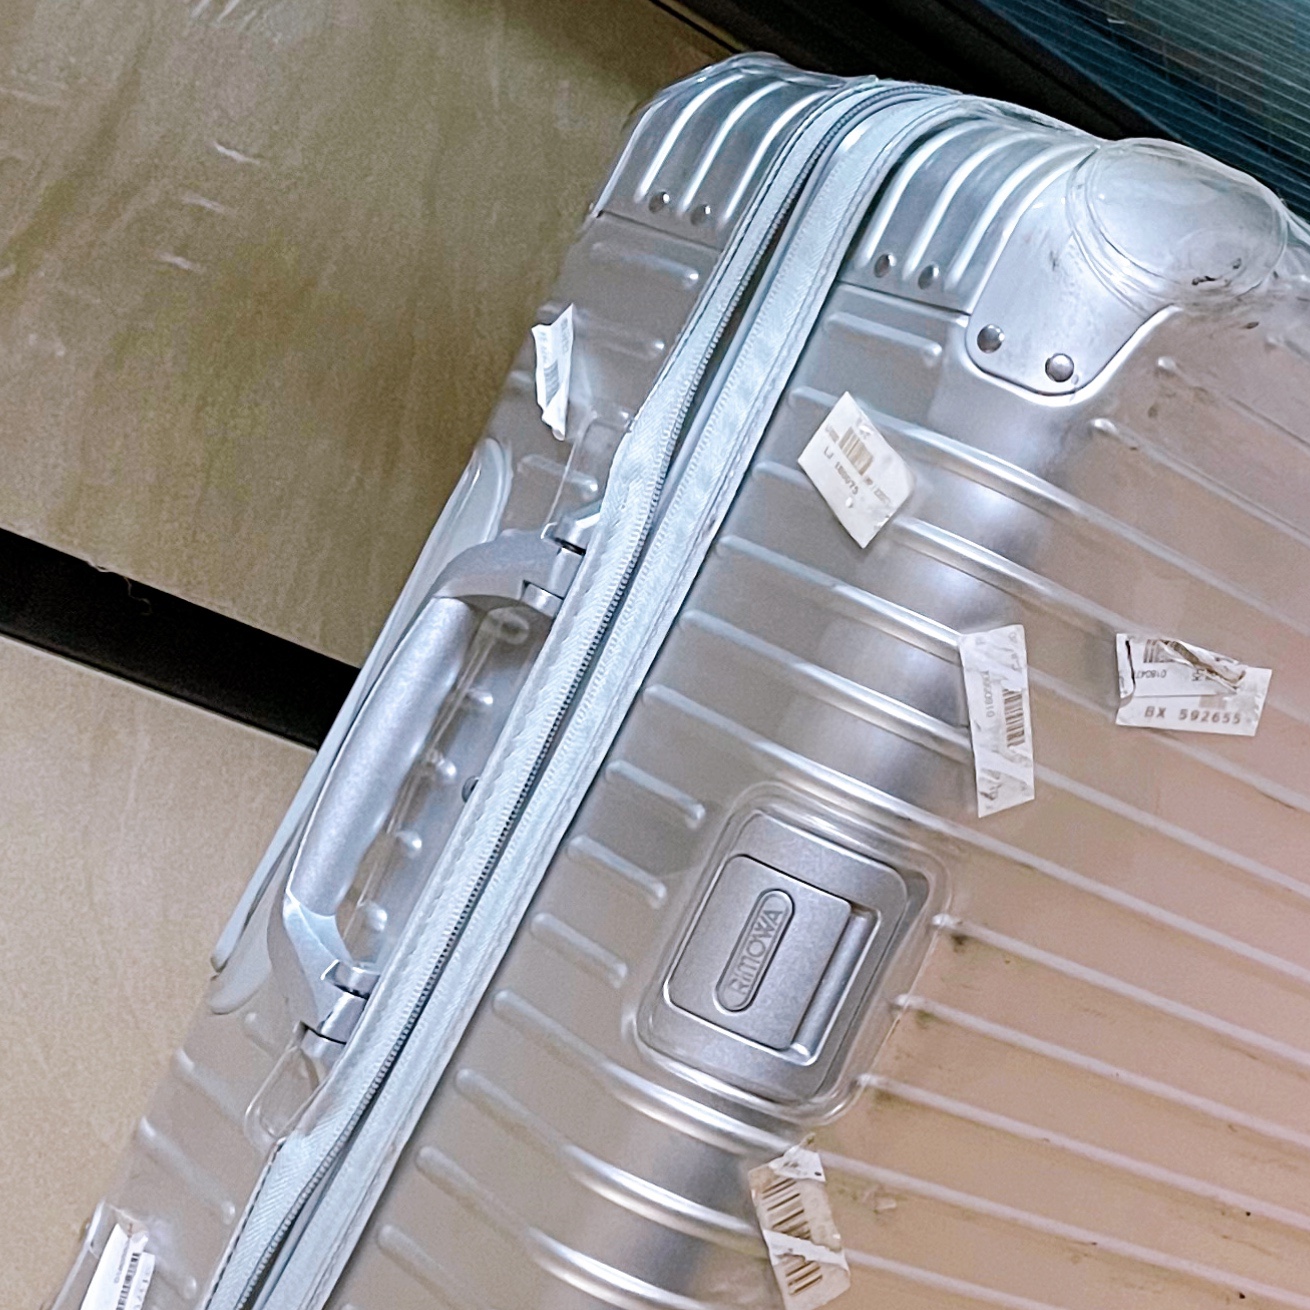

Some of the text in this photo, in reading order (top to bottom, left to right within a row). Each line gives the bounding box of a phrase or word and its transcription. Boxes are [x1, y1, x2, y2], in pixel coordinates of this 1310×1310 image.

[1144, 705, 1242, 725] BX 592655
[727, 908, 784, 996] RIMOWA
